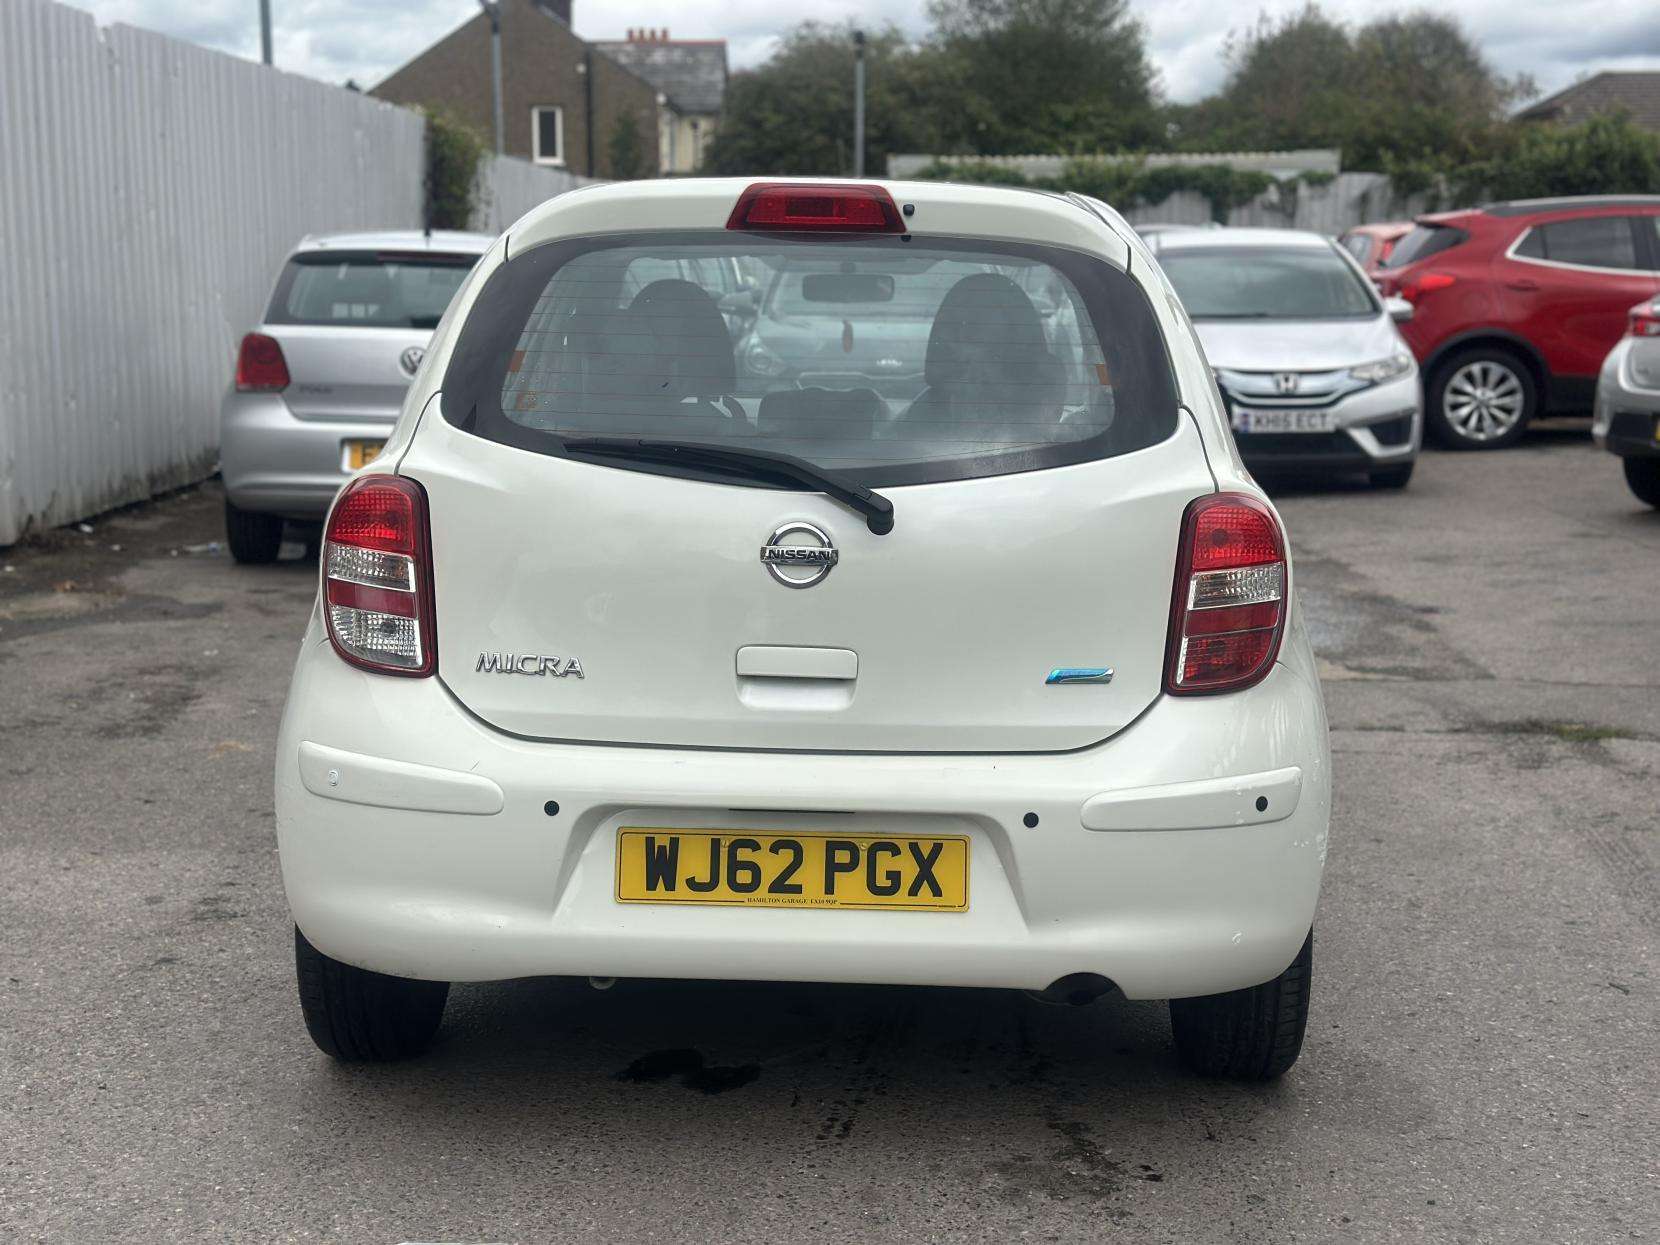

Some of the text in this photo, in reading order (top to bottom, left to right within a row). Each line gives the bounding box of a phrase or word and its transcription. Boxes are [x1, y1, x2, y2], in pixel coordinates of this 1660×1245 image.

[767, 549, 831, 561] NISSAN
[476, 651, 585, 680] MICRA
[644, 836, 944, 898] WJ62 PGX
